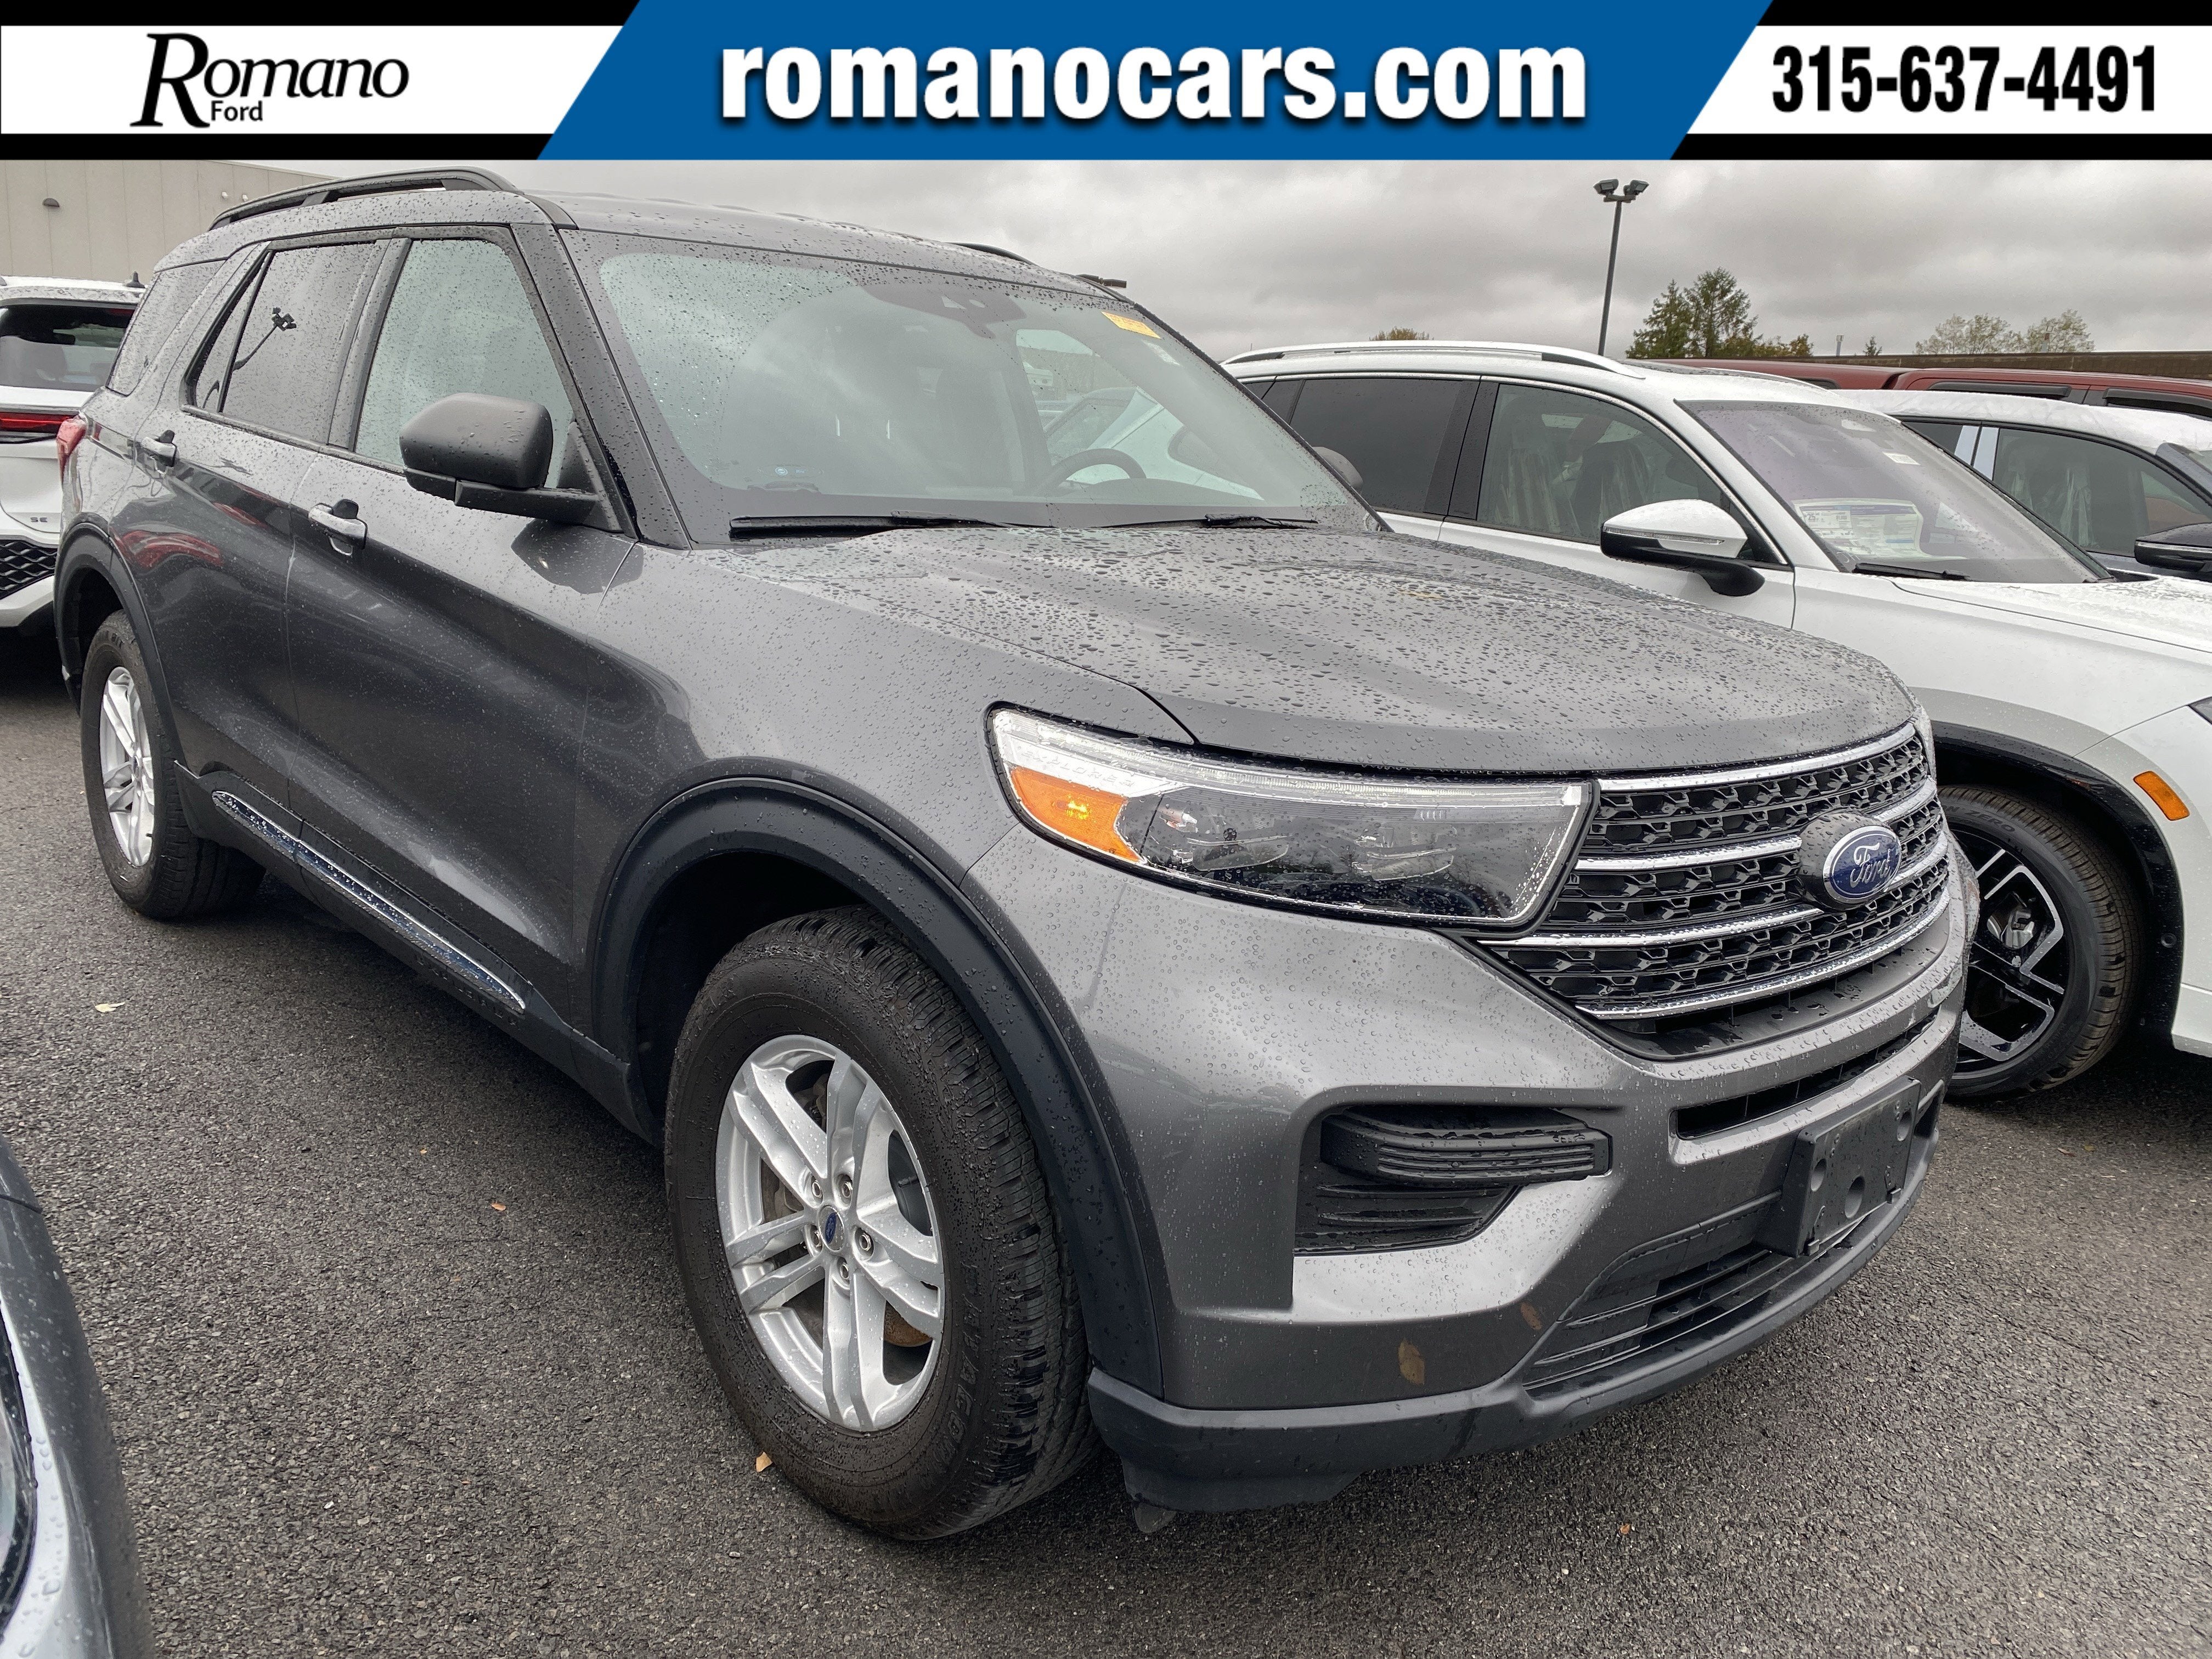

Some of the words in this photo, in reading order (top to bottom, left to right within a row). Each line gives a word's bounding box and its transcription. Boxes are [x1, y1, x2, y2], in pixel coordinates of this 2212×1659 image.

[1021, 750, 1136, 788] EXPLORER
[1964, 809, 2016, 833] ZERO
[1849, 842, 1893, 889] Ford
